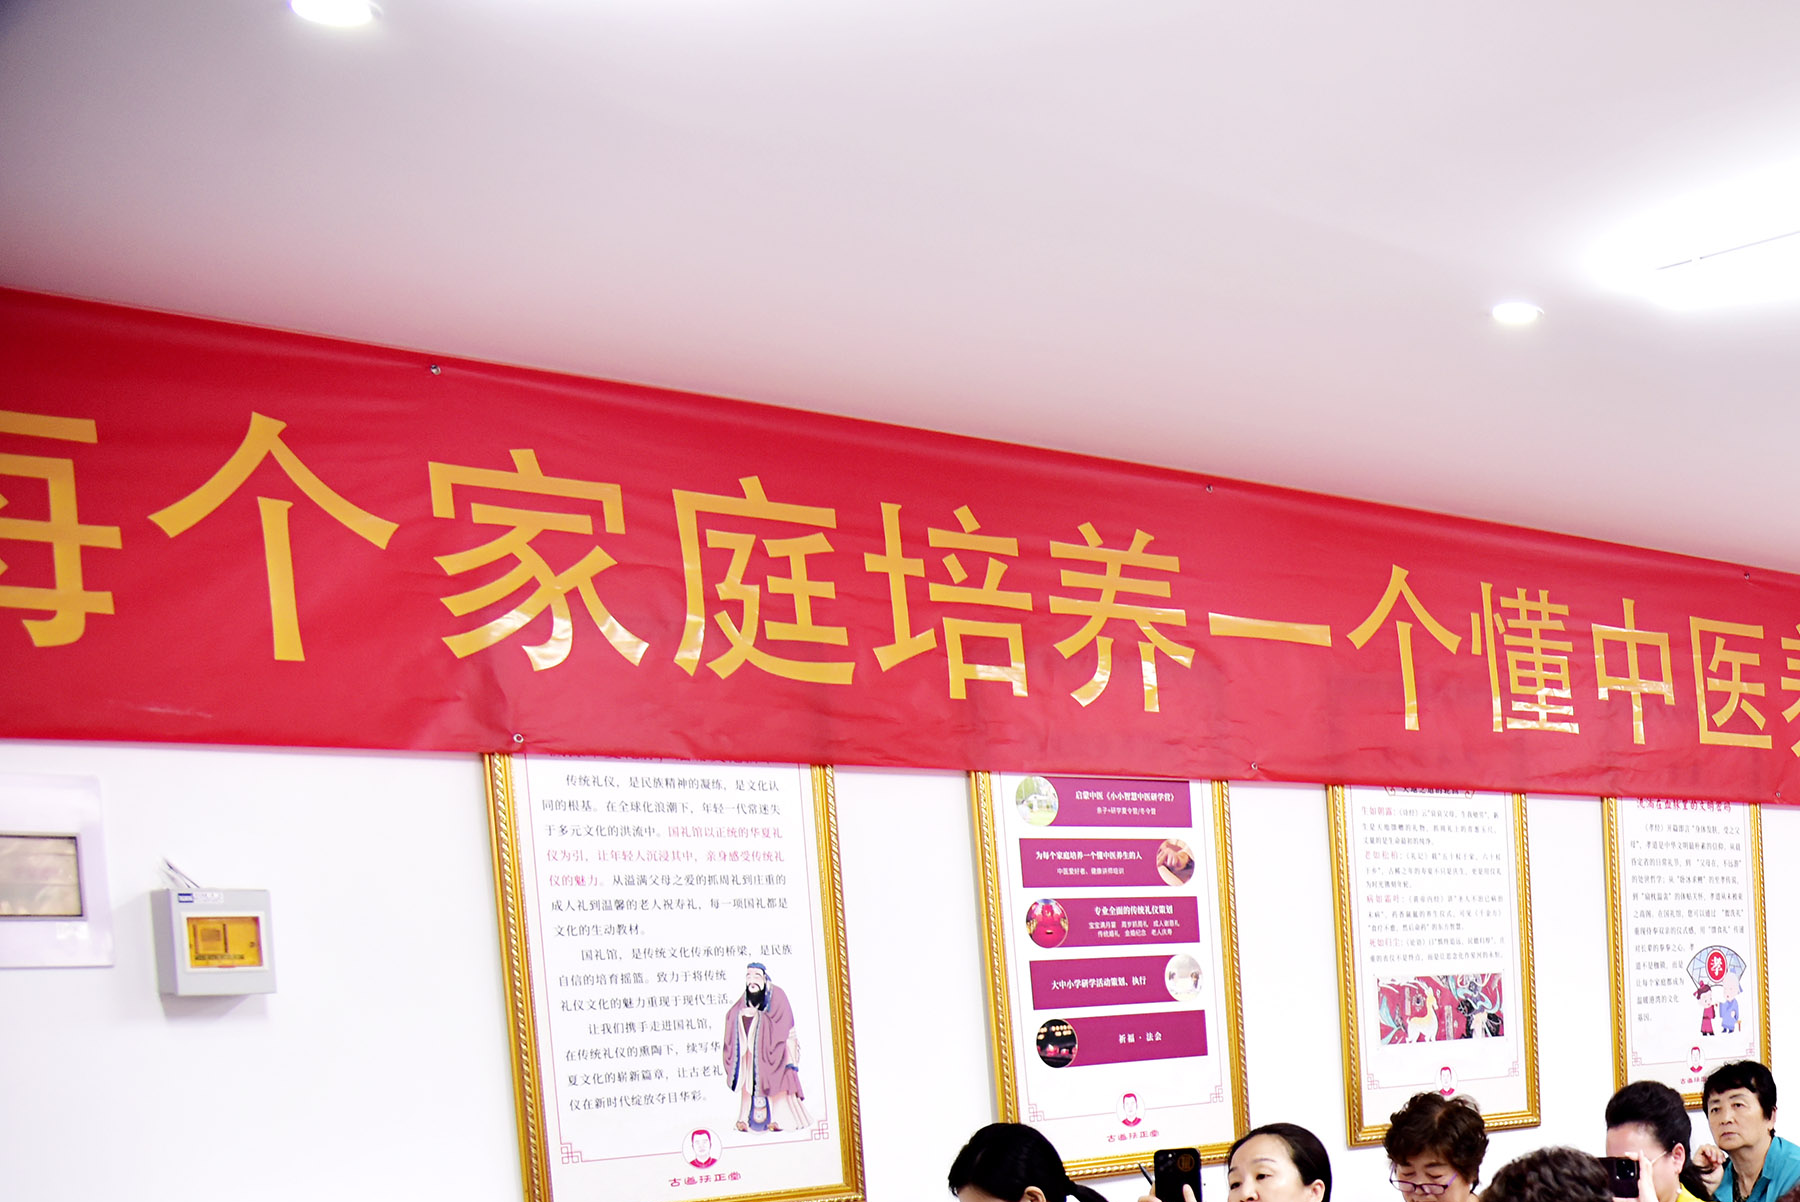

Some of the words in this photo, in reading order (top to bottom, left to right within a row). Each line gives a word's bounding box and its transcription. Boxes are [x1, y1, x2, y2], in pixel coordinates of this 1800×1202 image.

[553, 923, 647, 937] 文化的生动教材。
